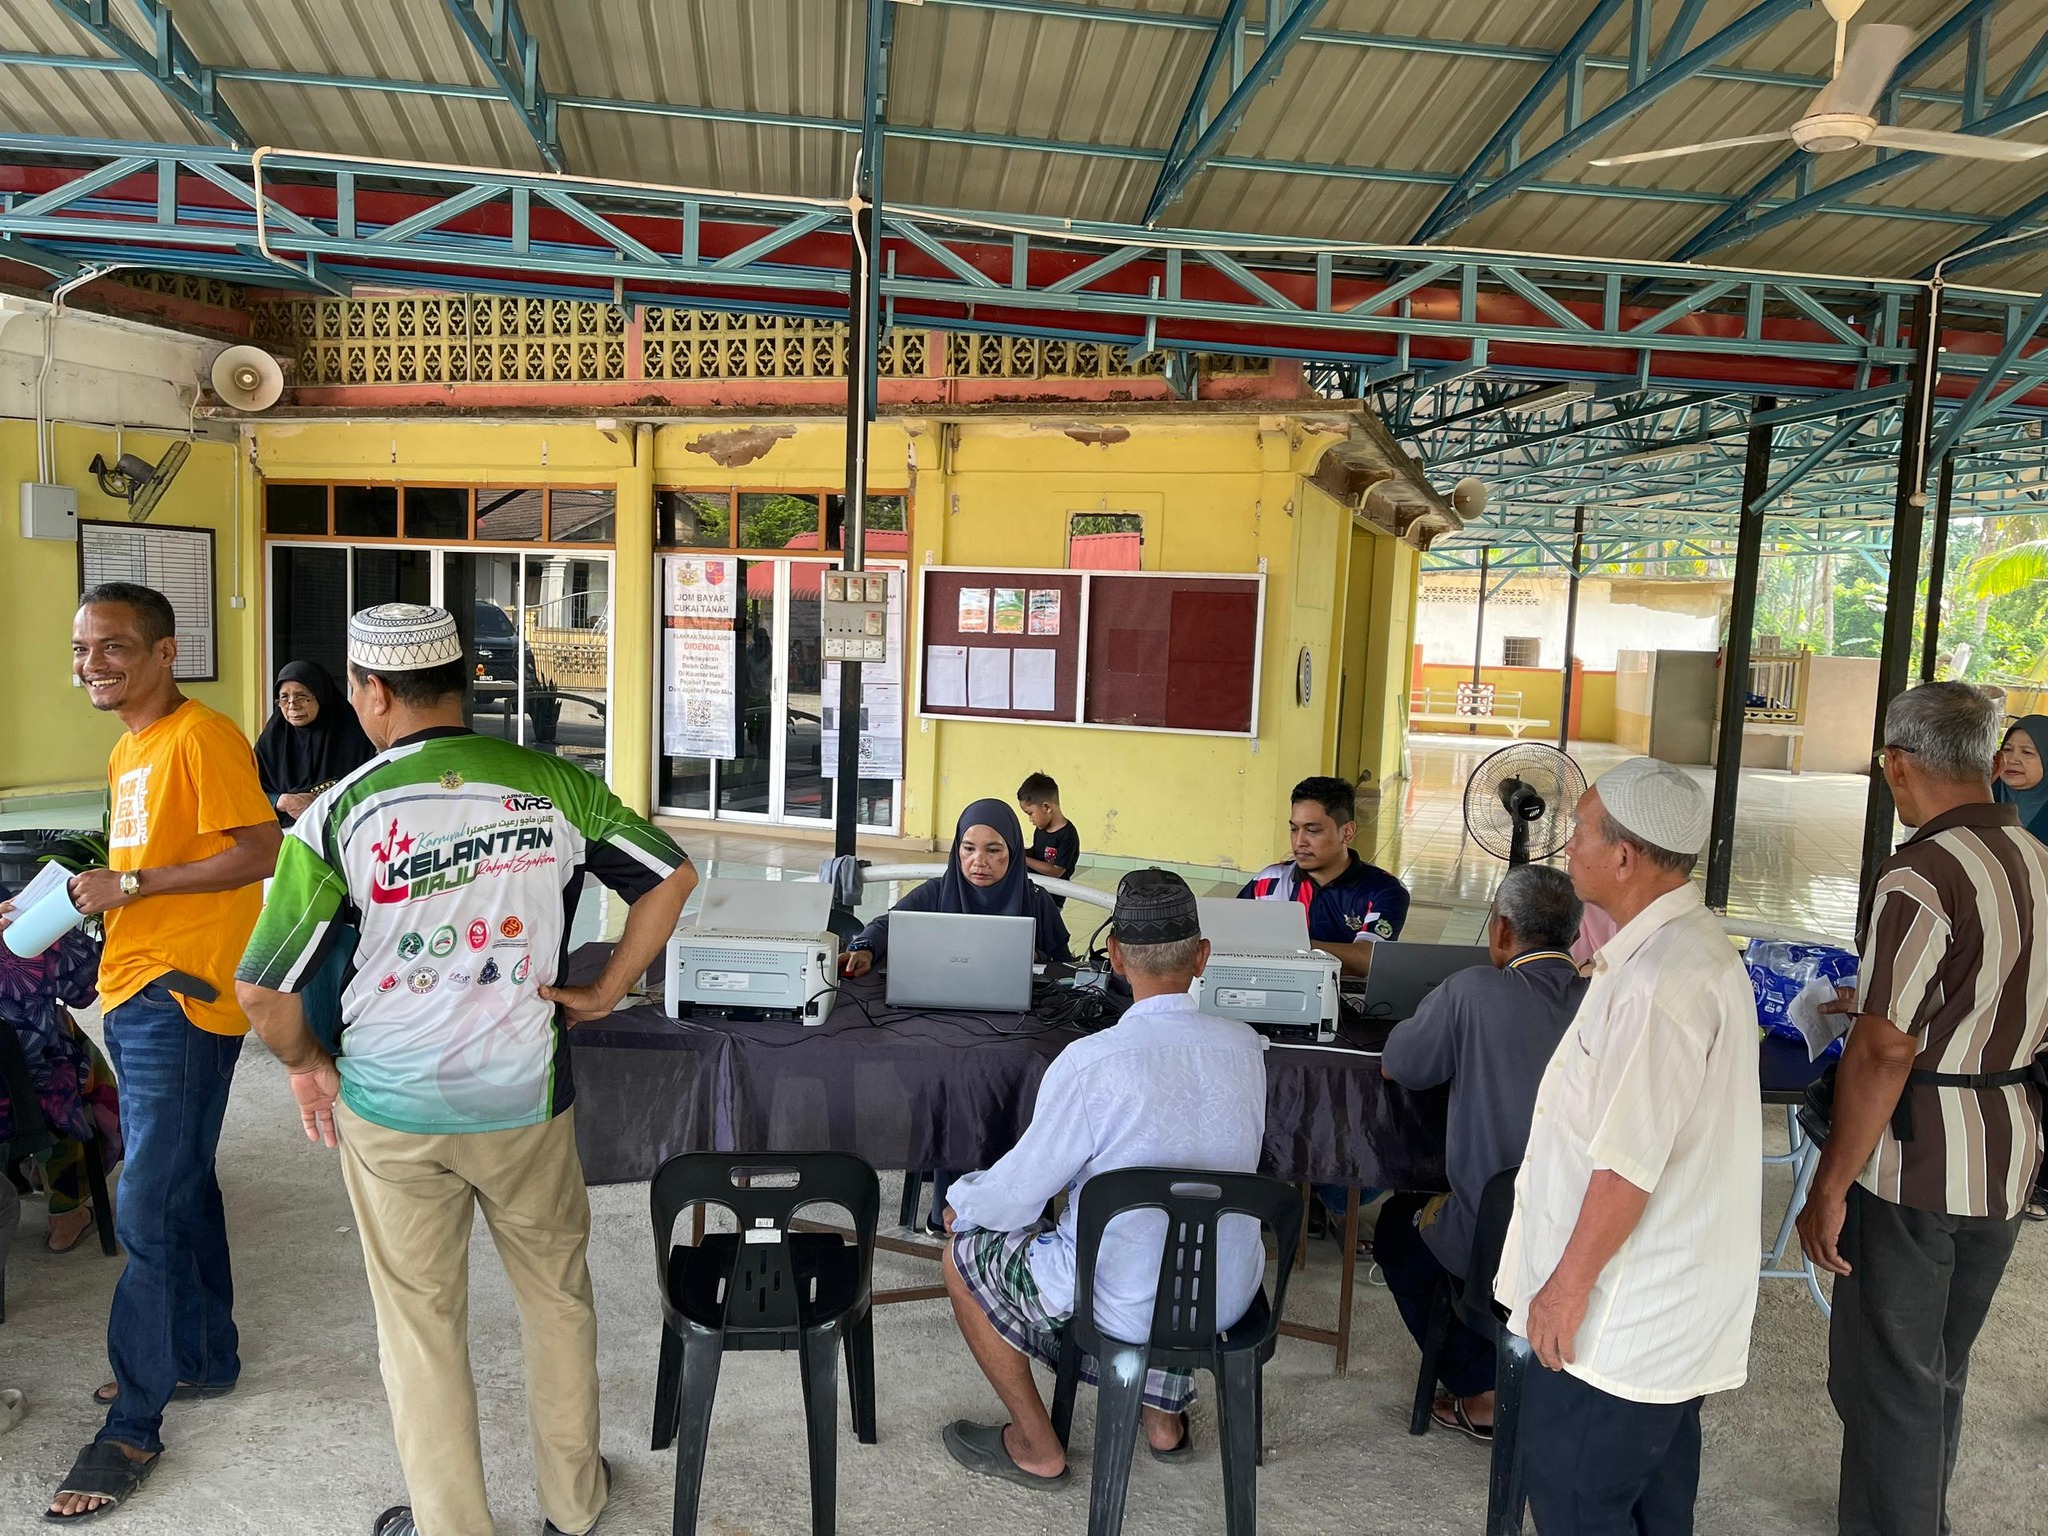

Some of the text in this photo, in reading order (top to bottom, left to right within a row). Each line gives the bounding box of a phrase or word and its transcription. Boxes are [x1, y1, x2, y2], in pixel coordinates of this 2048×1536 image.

[677, 593, 725, 603] JOM BAYAR
[673, 604, 729, 614] CUKAI TANAH
[684, 642, 720, 651] DIDENDA
[388, 827, 554, 886] KELANTAN
[410, 862, 480, 901] MAJU
